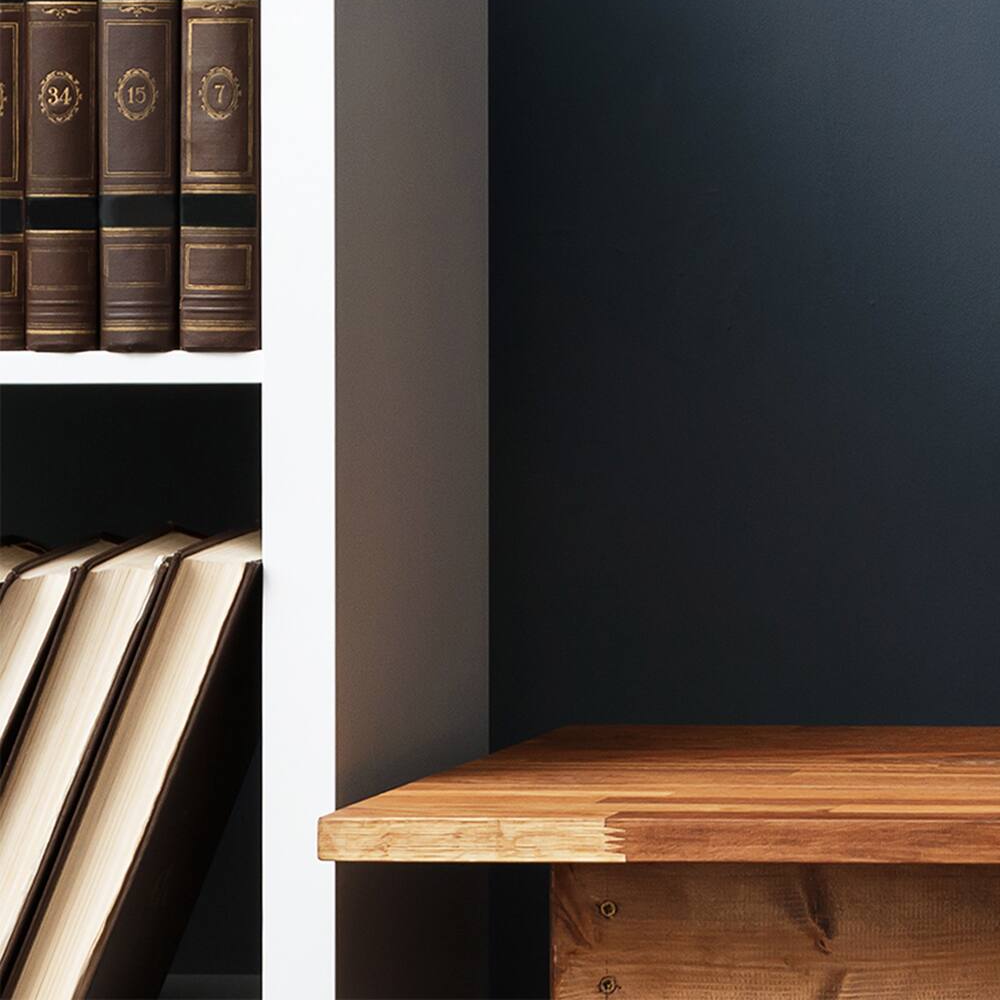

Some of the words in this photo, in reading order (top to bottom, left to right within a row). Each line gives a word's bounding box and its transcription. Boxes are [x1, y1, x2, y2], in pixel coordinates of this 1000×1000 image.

[48, 86, 72, 105] 34
[127, 86, 146, 104] 15
[214, 85, 225, 103] 7
